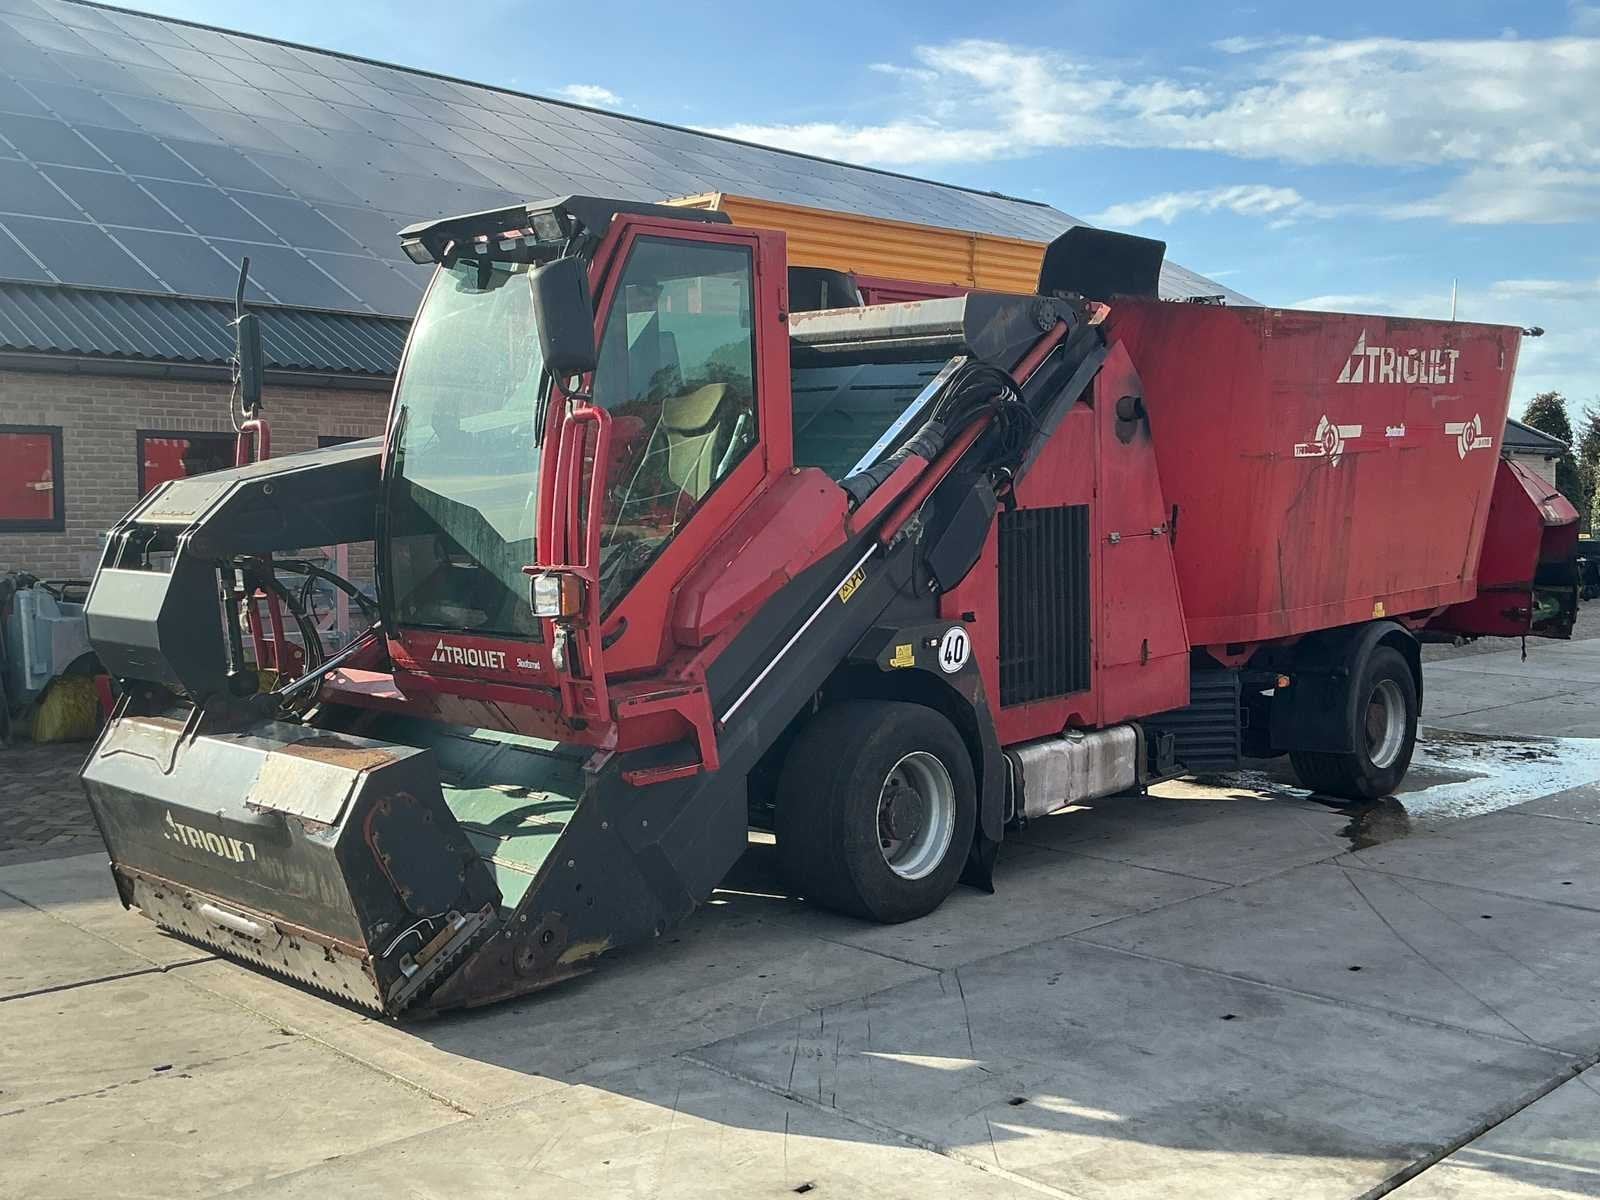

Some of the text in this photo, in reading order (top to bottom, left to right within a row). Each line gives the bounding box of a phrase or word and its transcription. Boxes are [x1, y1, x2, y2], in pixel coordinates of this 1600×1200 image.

[1366, 346, 1459, 384] TRIOLIET
[444, 646, 505, 669] TRIOLIET
[944, 634, 964, 664] 40
